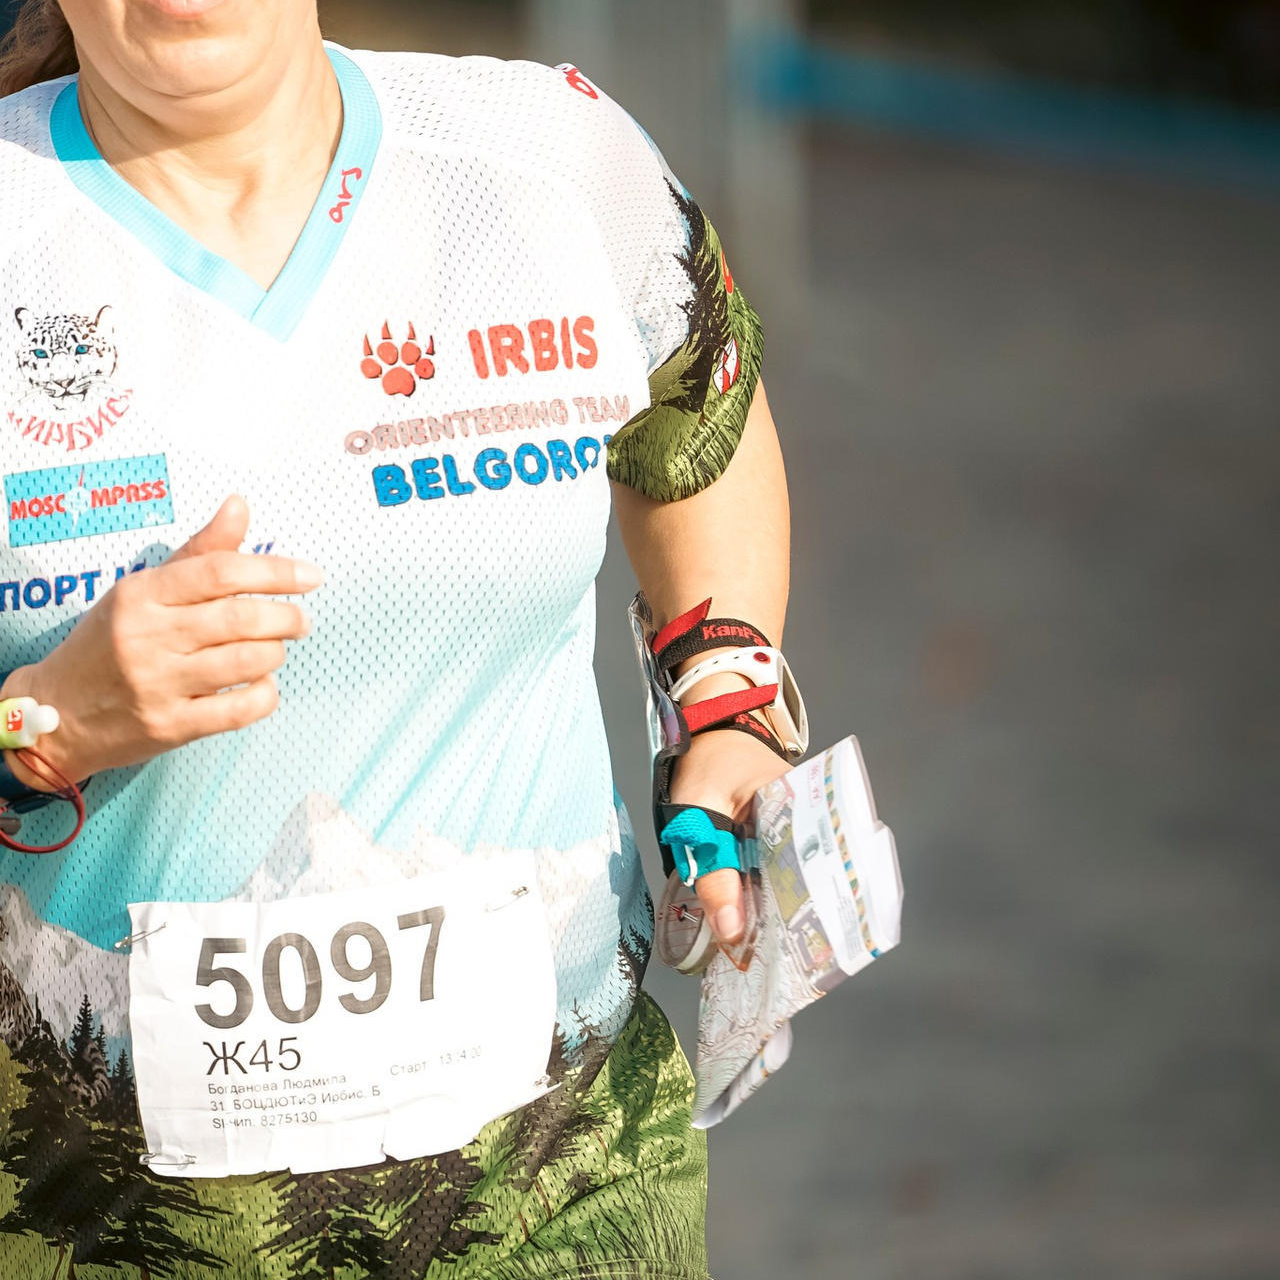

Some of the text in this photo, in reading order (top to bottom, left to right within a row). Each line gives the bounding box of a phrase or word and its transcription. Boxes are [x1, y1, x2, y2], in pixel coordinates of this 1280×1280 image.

[468, 315, 598, 379] IRBIS
[344, 394, 631, 456] ORIENTEERING TEAM
[372, 434, 613, 507] BELGORO
[194, 905, 446, 1029] 5097
[202, 1036, 302, 1077] Ж45
[208, 1074, 347, 1095] Богданова Людмила
[371, 1084, 381, 1097] Б
[260, 1110, 318, 1127] 8275130
